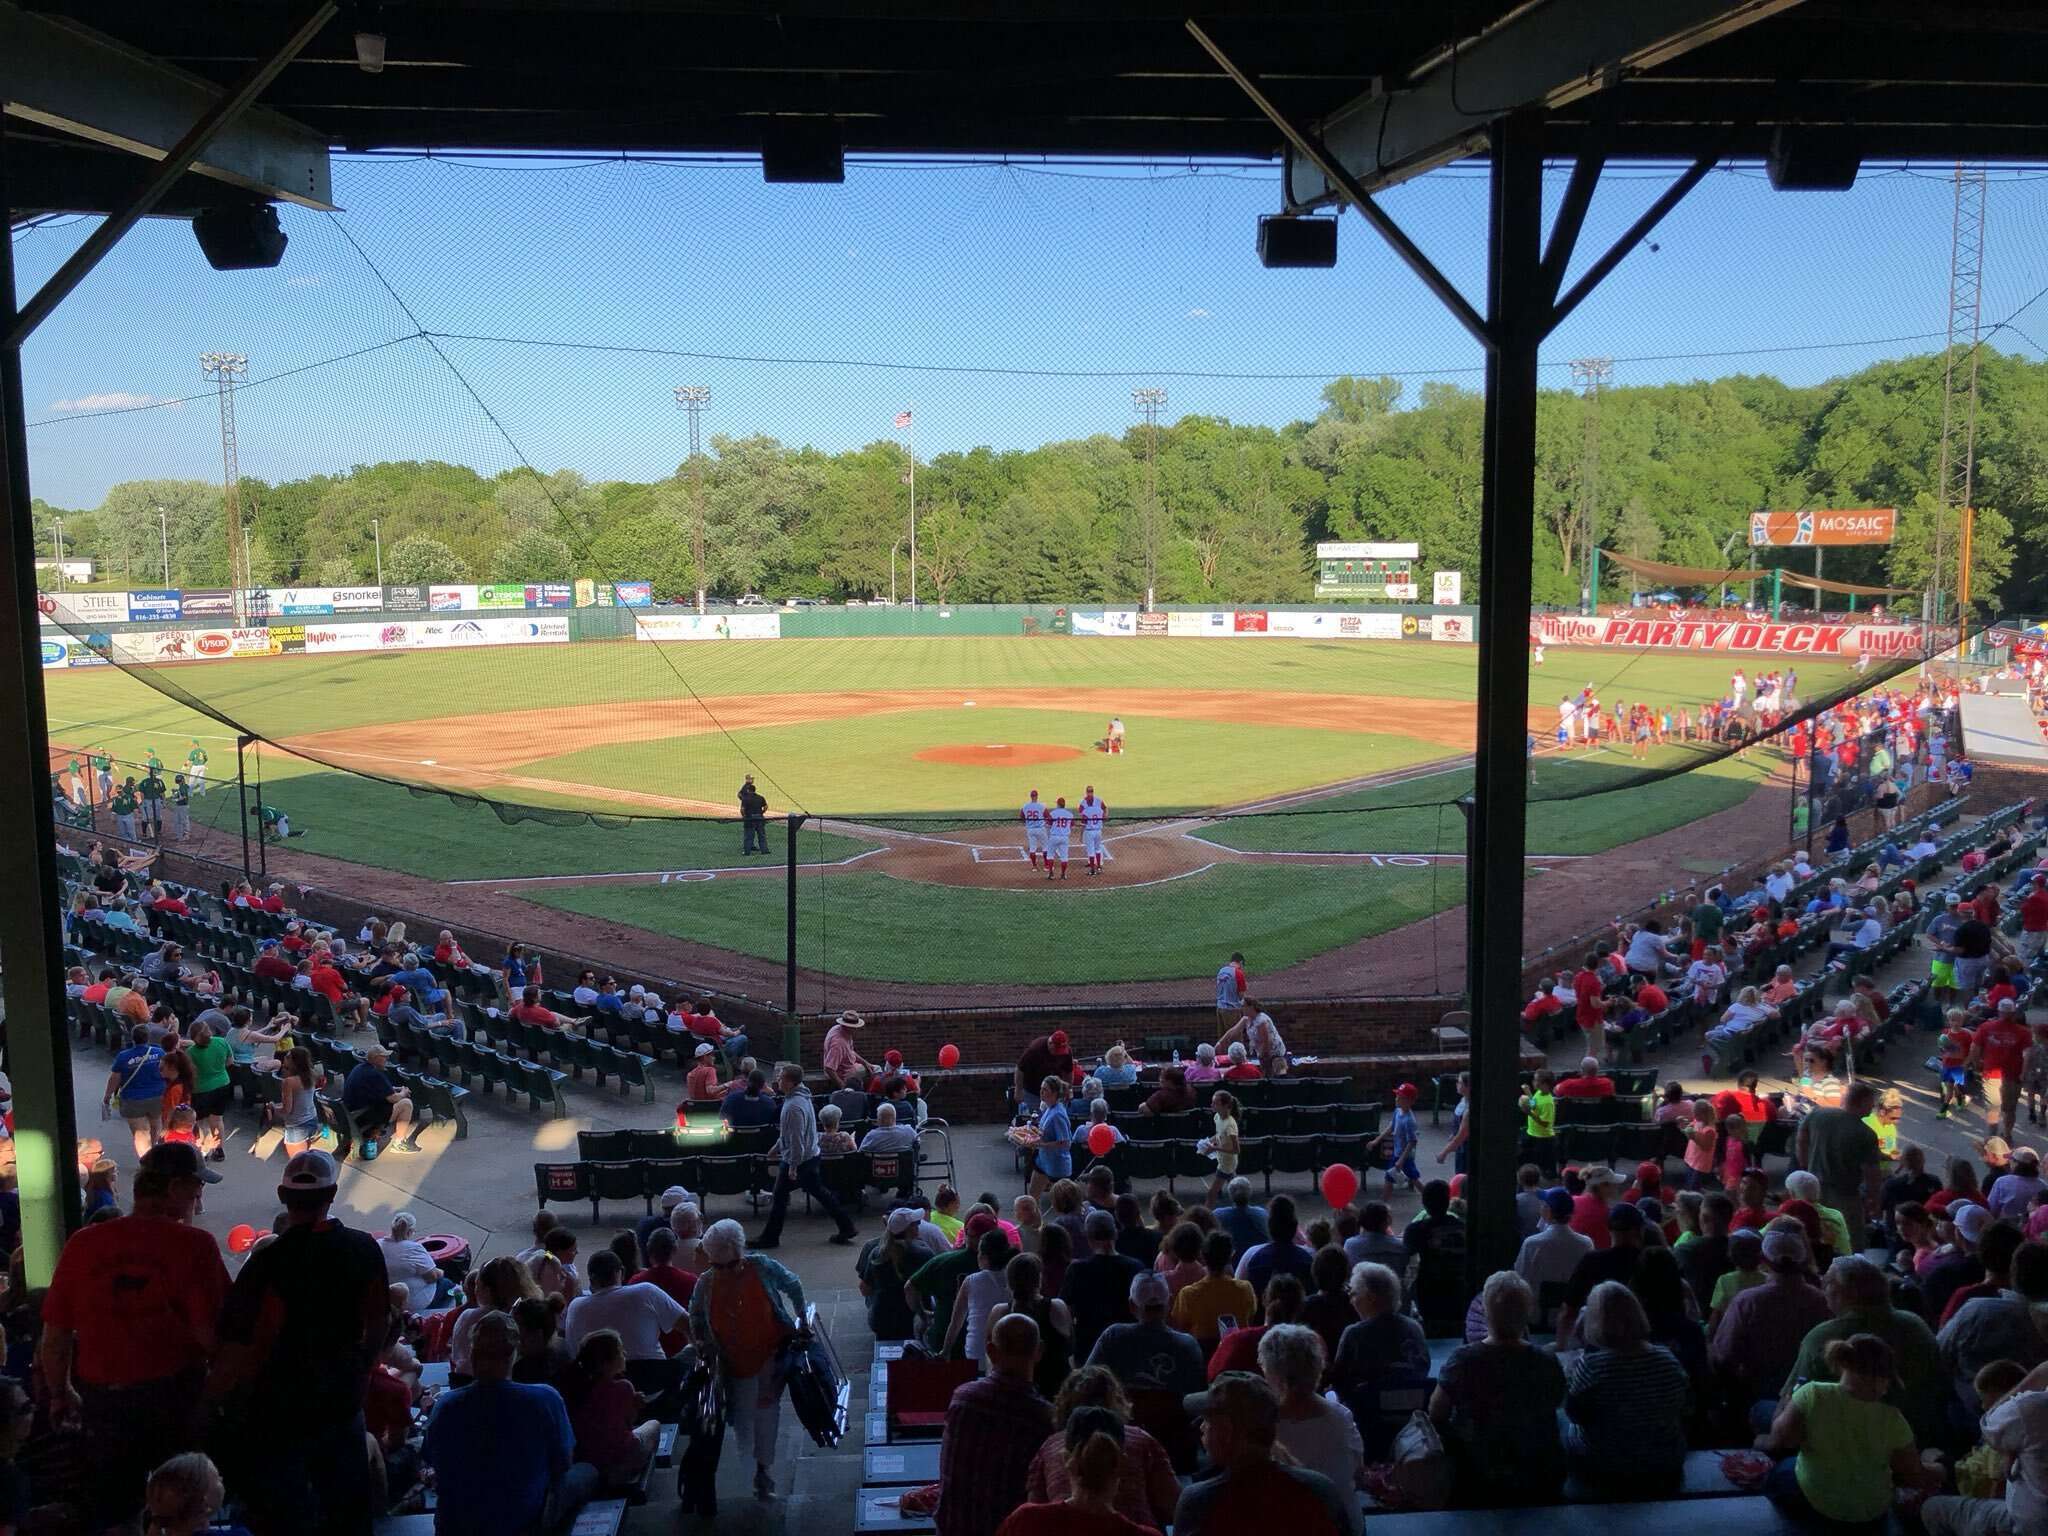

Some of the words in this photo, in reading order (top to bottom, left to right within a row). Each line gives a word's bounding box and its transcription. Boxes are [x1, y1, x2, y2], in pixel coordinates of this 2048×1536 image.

[1819, 516, 1884, 531] MOSAIC
[83, 595, 119, 608] STIFEL
[343, 591, 382, 601] snorkel
[1544, 620, 1596, 641] HyVee
[1601, 618, 1731, 648] PARTY
[1728, 621, 1855, 655] DECK
[200, 637, 228, 651] Tyson
[306, 632, 337, 646] HyVee
